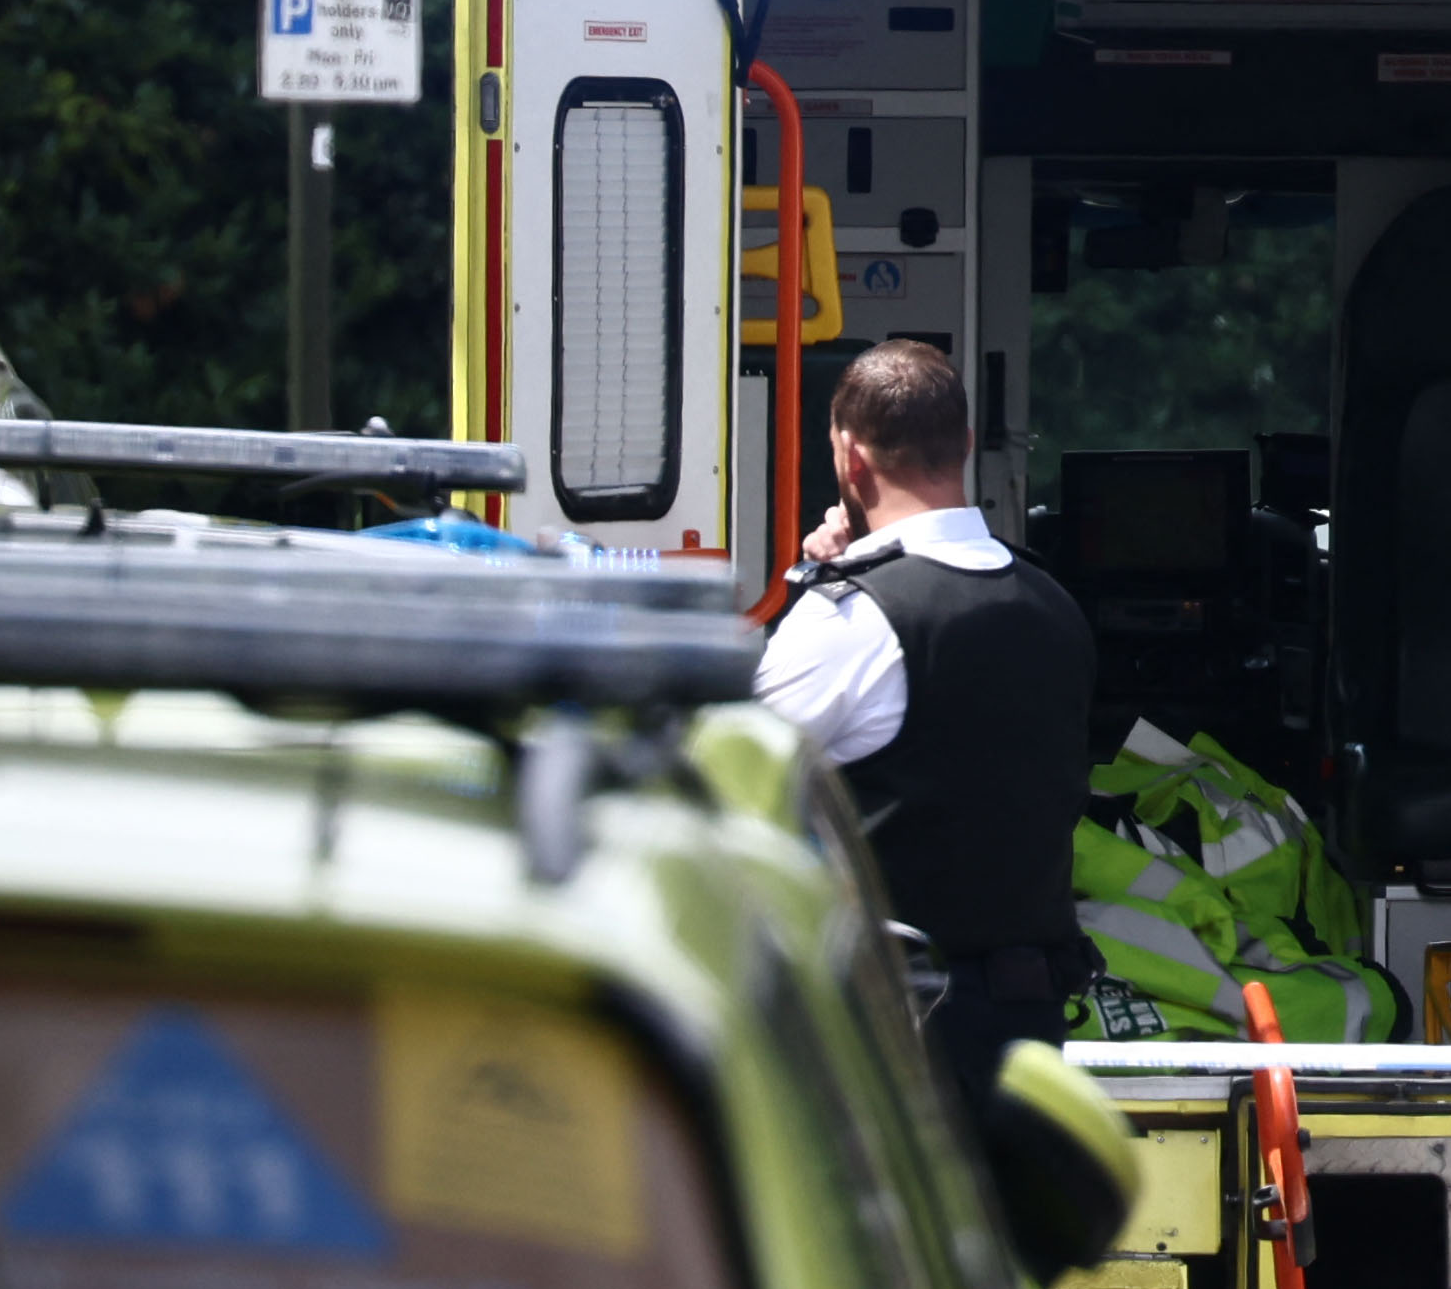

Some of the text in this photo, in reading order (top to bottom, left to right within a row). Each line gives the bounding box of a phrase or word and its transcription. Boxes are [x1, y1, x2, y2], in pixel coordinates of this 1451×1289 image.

[317, 3, 377, 19] holders
[330, 23, 364, 41] only
[588, 25, 644, 37] EMERGENCY EXIT
